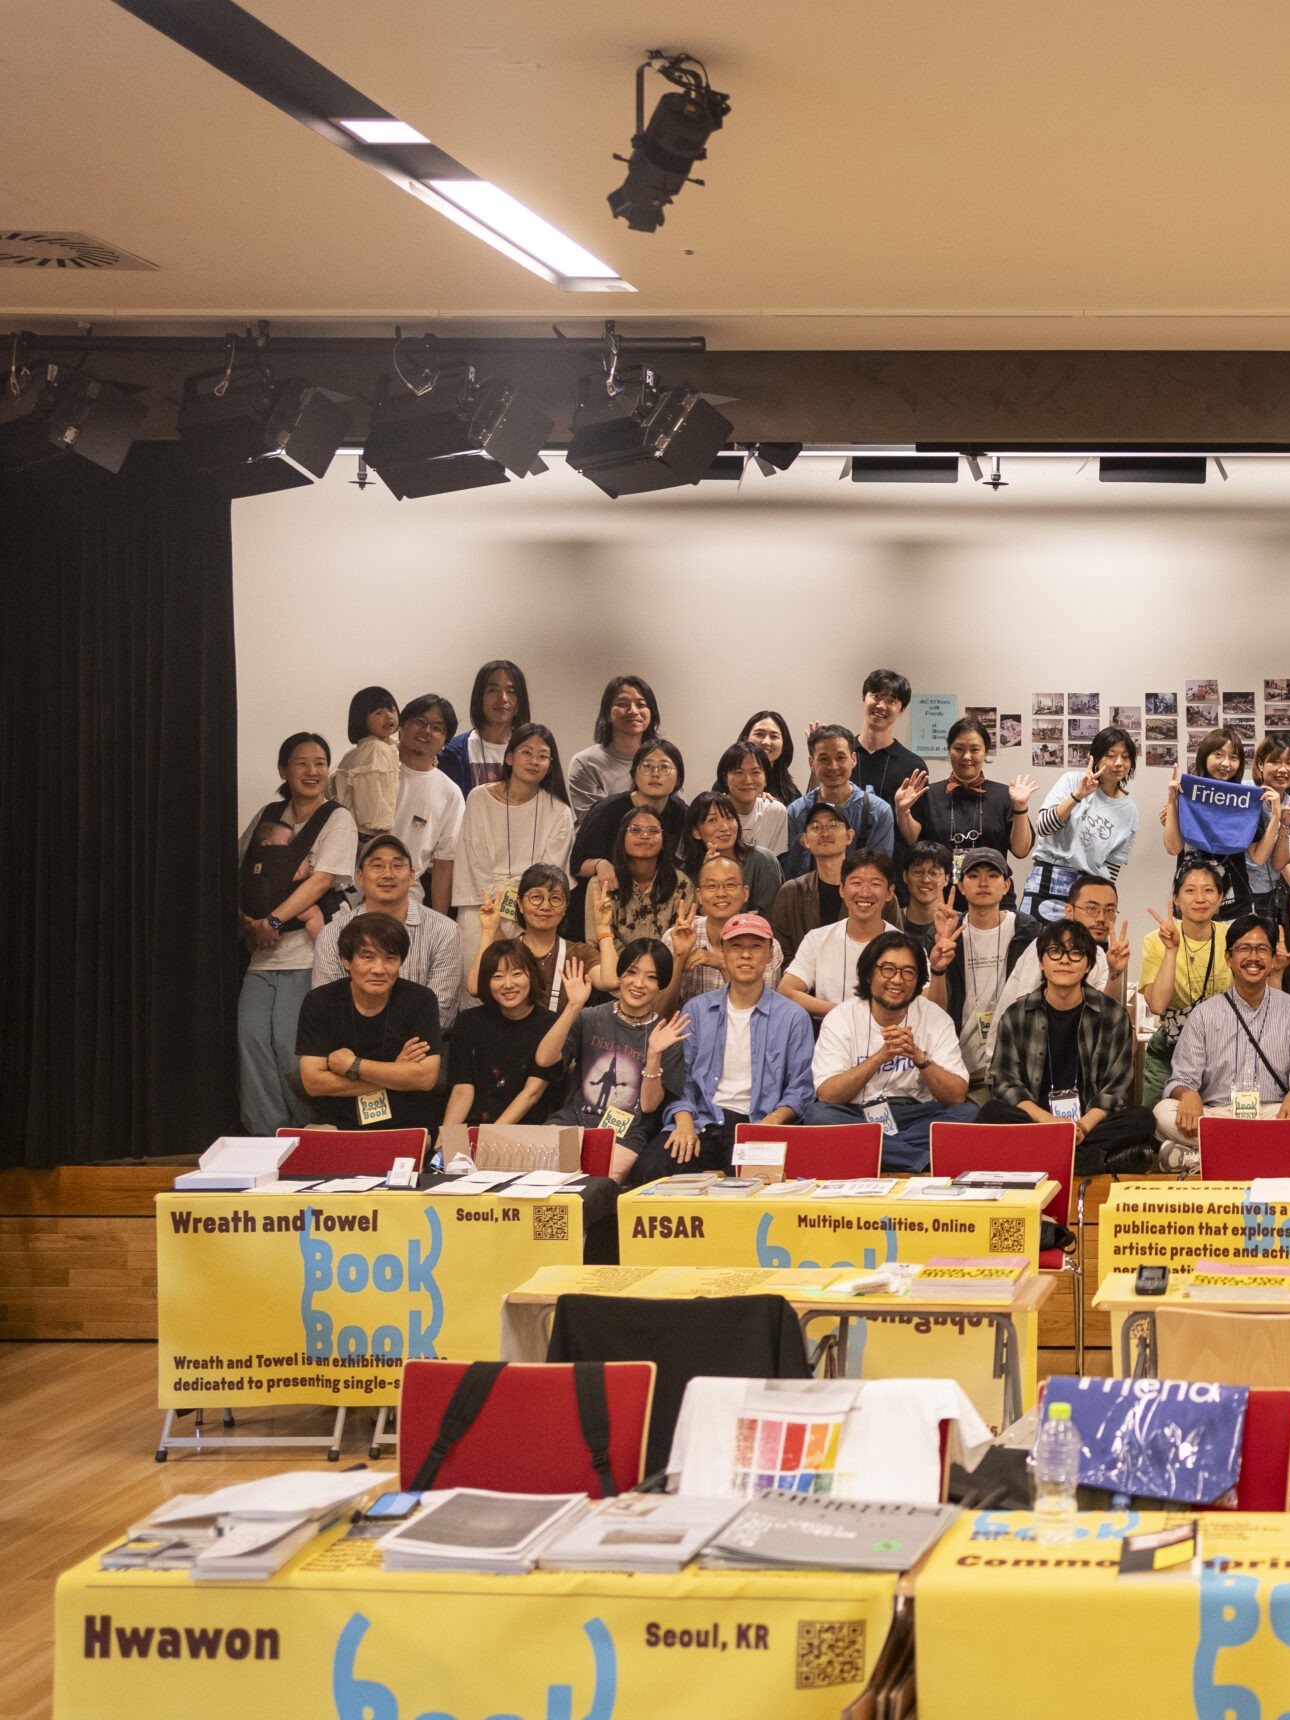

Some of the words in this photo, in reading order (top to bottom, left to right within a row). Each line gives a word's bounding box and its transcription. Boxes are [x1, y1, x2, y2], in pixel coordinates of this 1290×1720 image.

[1191, 784, 1251, 809] Friend
[456, 1207, 499, 1223] Seoul,
[502, 1208, 521, 1222] KR
[1142, 1202, 1204, 1214] Invisible
[1207, 1202, 1262, 1216] Archive
[1264, 1203, 1276, 1216] is
[1279, 1206, 1288, 1216] a
[170, 1210, 257, 1234] Wreath
[262, 1209, 306, 1233] and
[310, 1208, 379, 1233] Towel
[632, 1214, 706, 1240] AFSAR
[797, 1214, 854, 1233] Multiple
[856, 1216, 930, 1234] Localities,
[932, 1218, 976, 1234] Online
[1114, 1221, 1195, 1238] publication
[1198, 1221, 1229, 1236] that
[1113, 1243, 1167, 1256] artistic
[1170, 1243, 1230, 1261] practice
[1233, 1244, 1259, 1258] and
[302, 1238, 441, 1294] Book
[173, 1355, 224, 1371] Wreath
[226, 1354, 253, 1370] and
[255, 1353, 299, 1369] Towel
[301, 1352, 313, 1366] is
[315, 1356, 330, 1368] an
[332, 1354, 403, 1369] exhibition
[173, 1376, 245, 1393] dedicated
[247, 1376, 264, 1391] to
[266, 1373, 341, 1394] presenting
[955, 1555, 1120, 1568] Commo
[82, 1614, 282, 1661] Hwawon
[644, 1621, 728, 1652] Seoul,
[735, 1623, 770, 1651] KR
